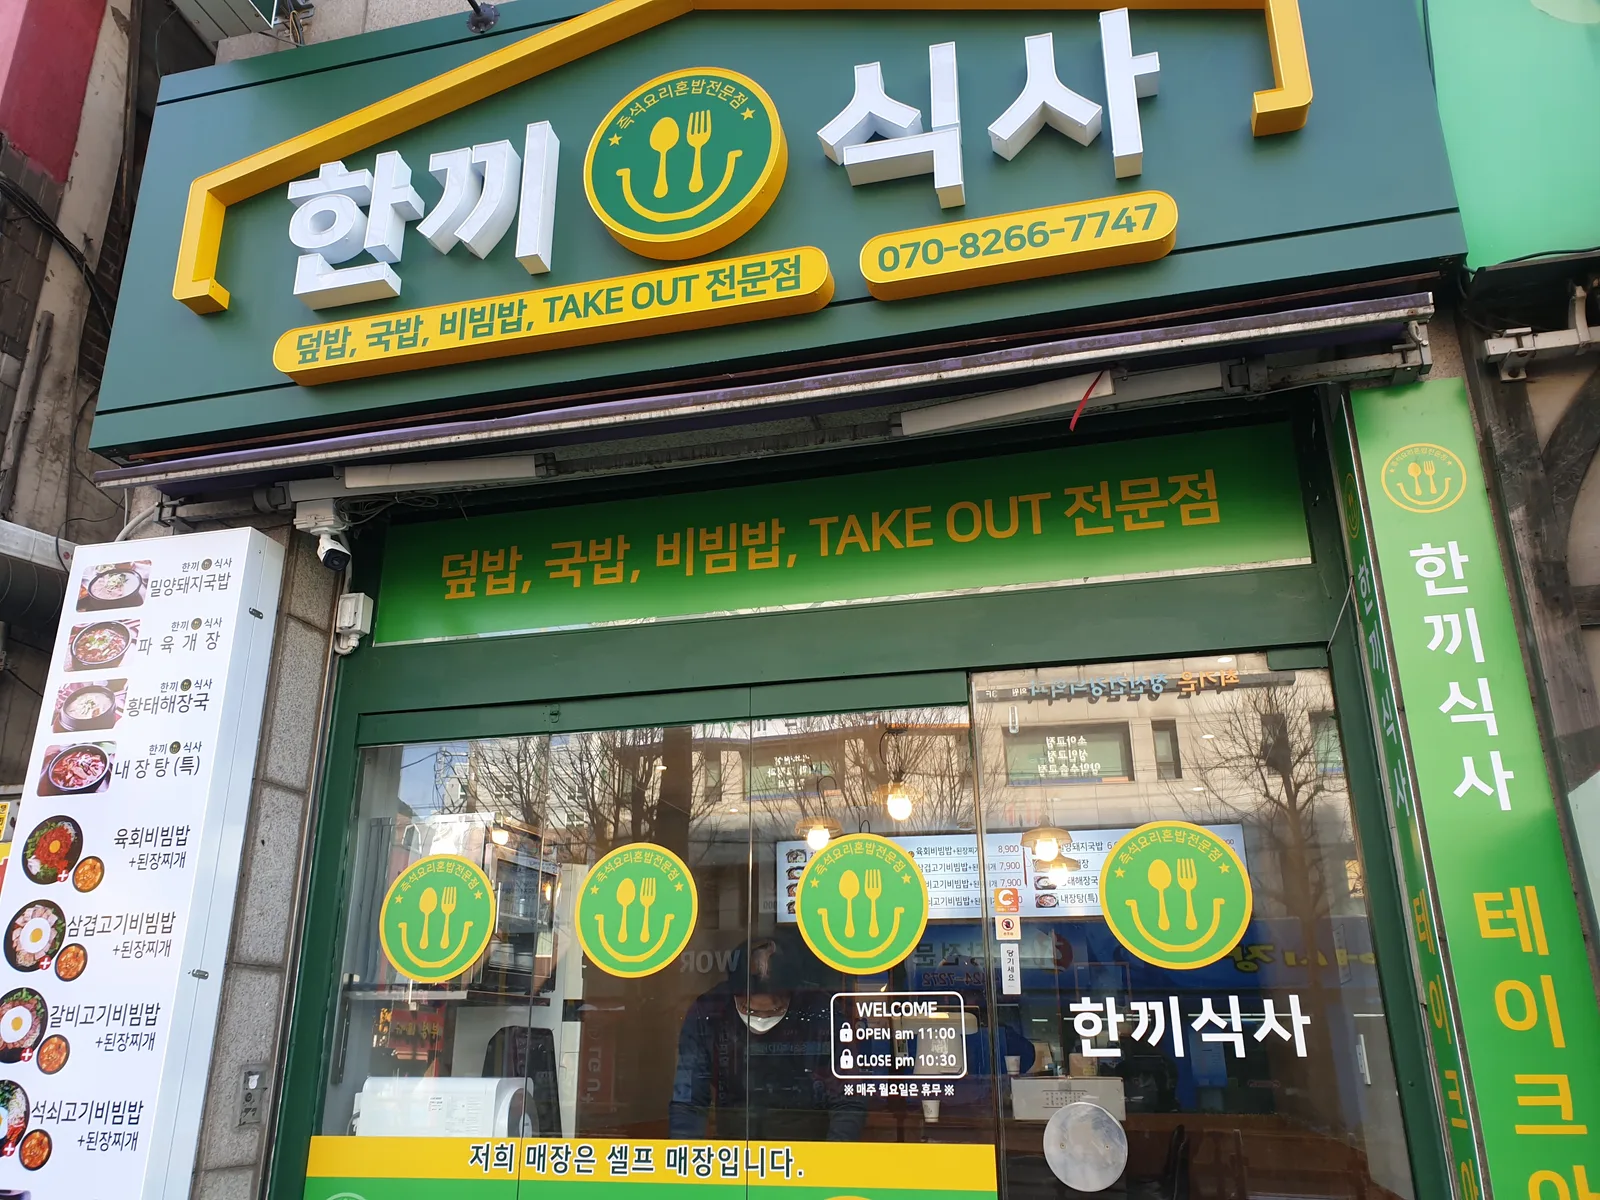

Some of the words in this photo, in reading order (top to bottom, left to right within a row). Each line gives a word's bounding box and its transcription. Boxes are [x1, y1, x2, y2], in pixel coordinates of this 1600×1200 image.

[616, 79, 749, 130] 즉석요리혼밥전문점
[287, 120, 561, 311] 한끼
[816, 7, 1160, 208] 식사
[877, 201, 1160, 274] 070-8266-7747
[297, 326, 357, 365] 덮밥,
[365, 314, 430, 352] 국밥,
[439, 298, 534, 341] 비빔밥,
[543, 286, 624, 323] TAKE
[631, 274, 700, 310] OUT
[705, 254, 801, 302] 전문점
[441, 545, 532, 600] 덮밥,
[544, 534, 641, 588] 국밥,
[656, 518, 797, 577] 비빔밥,
[808, 503, 935, 558] TAKE
[945, 490, 1051, 543] OUT
[1062, 468, 1220, 538] 전문점
[150, 572, 231, 597] 밀양돼지국밥
[126, 693, 210, 717] 황태해장국
[113, 825, 190, 849] 육회비빔밥
[998, 845, 1019, 854] 8,900
[1118, 829, 1224, 865] 즉석요리혼밥전문점
[128, 851, 187, 870] +된장찌개
[596, 850, 681, 883] 즉석요리혼밥전문점
[815, 841, 907, 876] 즉석요리혼밥전문점
[999, 861, 1020, 871] 7,900
[400, 860, 480, 892] 즉석요리혼밥전문점
[1001, 878, 1021, 888] 7,900
[67, 912, 176, 938] 삼겹고기비빔밥
[112, 939, 172, 959] +된장찌개
[1007, 949, 1015, 981] 당기세요
[49, 1002, 161, 1028] 갈비고기비빔밥
[856, 1001, 937, 1017] WELCOME
[856, 1027, 891, 1040] OPEN
[895, 1029, 914, 1040] am
[918, 1027, 956, 1040] 11:00
[1069, 994, 1311, 1059] 한끼식사
[95, 1032, 156, 1052] +된장찌개
[856, 1054, 891, 1067] CLOSE
[895, 1056, 914, 1069] pm
[918, 1054, 956, 1067] 10:30
[856, 1083, 876, 1096] 매주
[879, 1083, 918, 1097] 월요일은
[921, 1083, 941, 1096] 휴무
[30, 1100, 144, 1125] 석쇠고기비빔밥
[77, 1131, 139, 1152] +된장찌개
[469, 1142, 514, 1174] 저희
[525, 1143, 597, 1176] 매장은
[606, 1144, 654, 1176] 셀프
[665, 1147, 805, 1180] 매장입니다.
